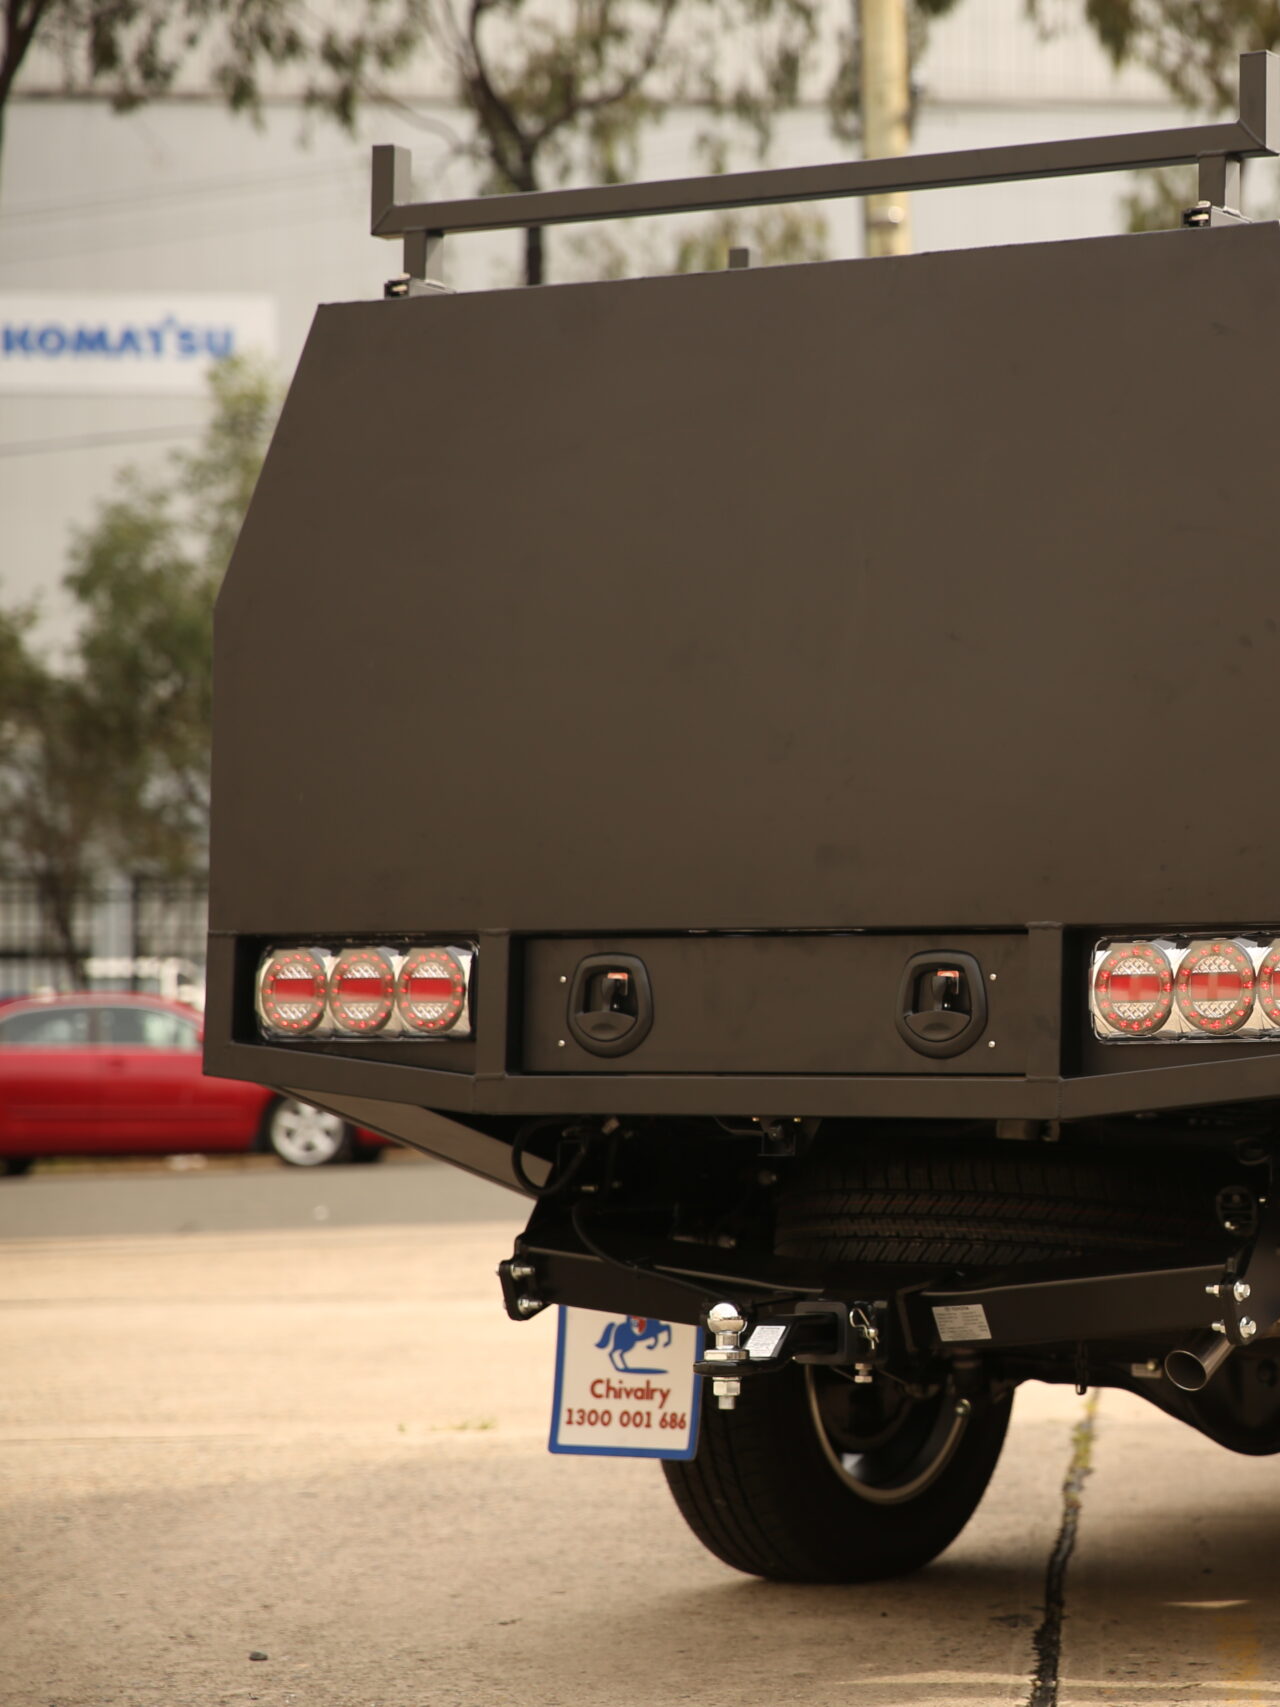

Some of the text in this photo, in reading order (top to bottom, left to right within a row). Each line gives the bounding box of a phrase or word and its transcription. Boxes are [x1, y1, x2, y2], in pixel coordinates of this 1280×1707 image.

[0, 318, 234, 356] KOMATSU
[589, 1377, 671, 1409] Chivalry
[565, 1407, 687, 1430] 1300 001 686
